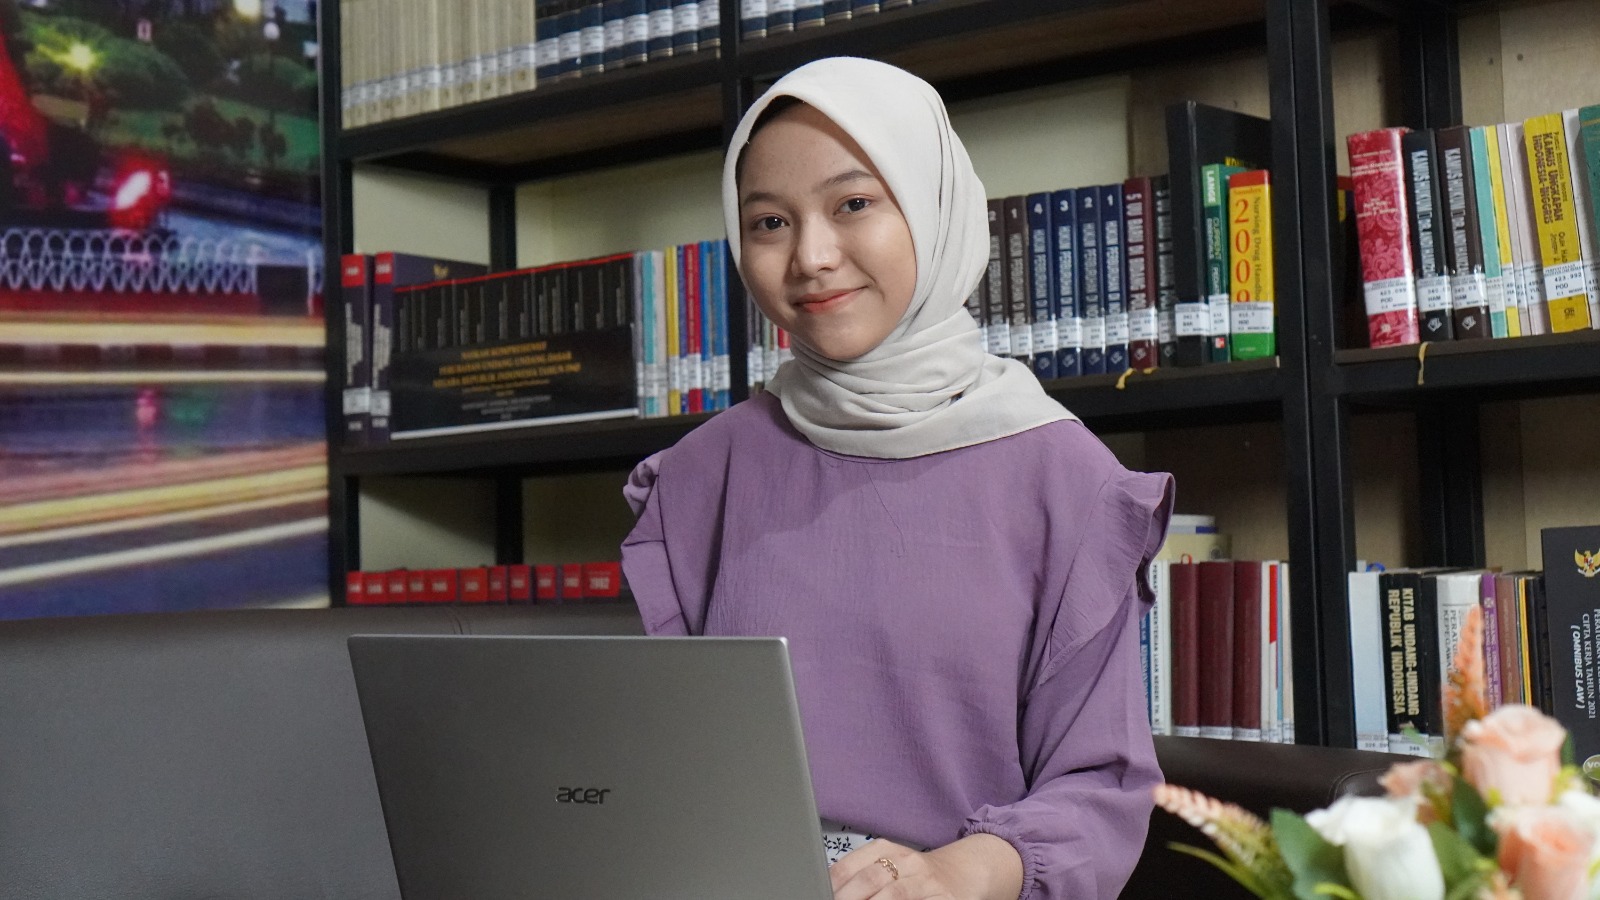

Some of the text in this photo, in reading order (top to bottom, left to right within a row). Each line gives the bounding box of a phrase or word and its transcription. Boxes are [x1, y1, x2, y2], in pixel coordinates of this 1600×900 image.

[1412, 150, 1431, 181] KAMUS
[1444, 148, 1462, 179] KAMUS
[1542, 132, 1563, 221] KAMUS UNGKAPAN
[1206, 170, 1216, 203] LANGE
[1034, 203, 1043, 214] 4
[1060, 200, 1069, 211] 3
[1252, 196, 1262, 302] Nursing Drug Handbo
[1582, 613, 1591, 640] CIPTA
[1387, 588, 1405, 715] REPUBLIK INDONESIA
[1402, 587, 1419, 716] KITAB UNDANG-UNDANG
[1585, 642, 1593, 668] KERJA
[1586, 669, 1594, 700] TAHUN
[556, 787, 611, 804] acer
